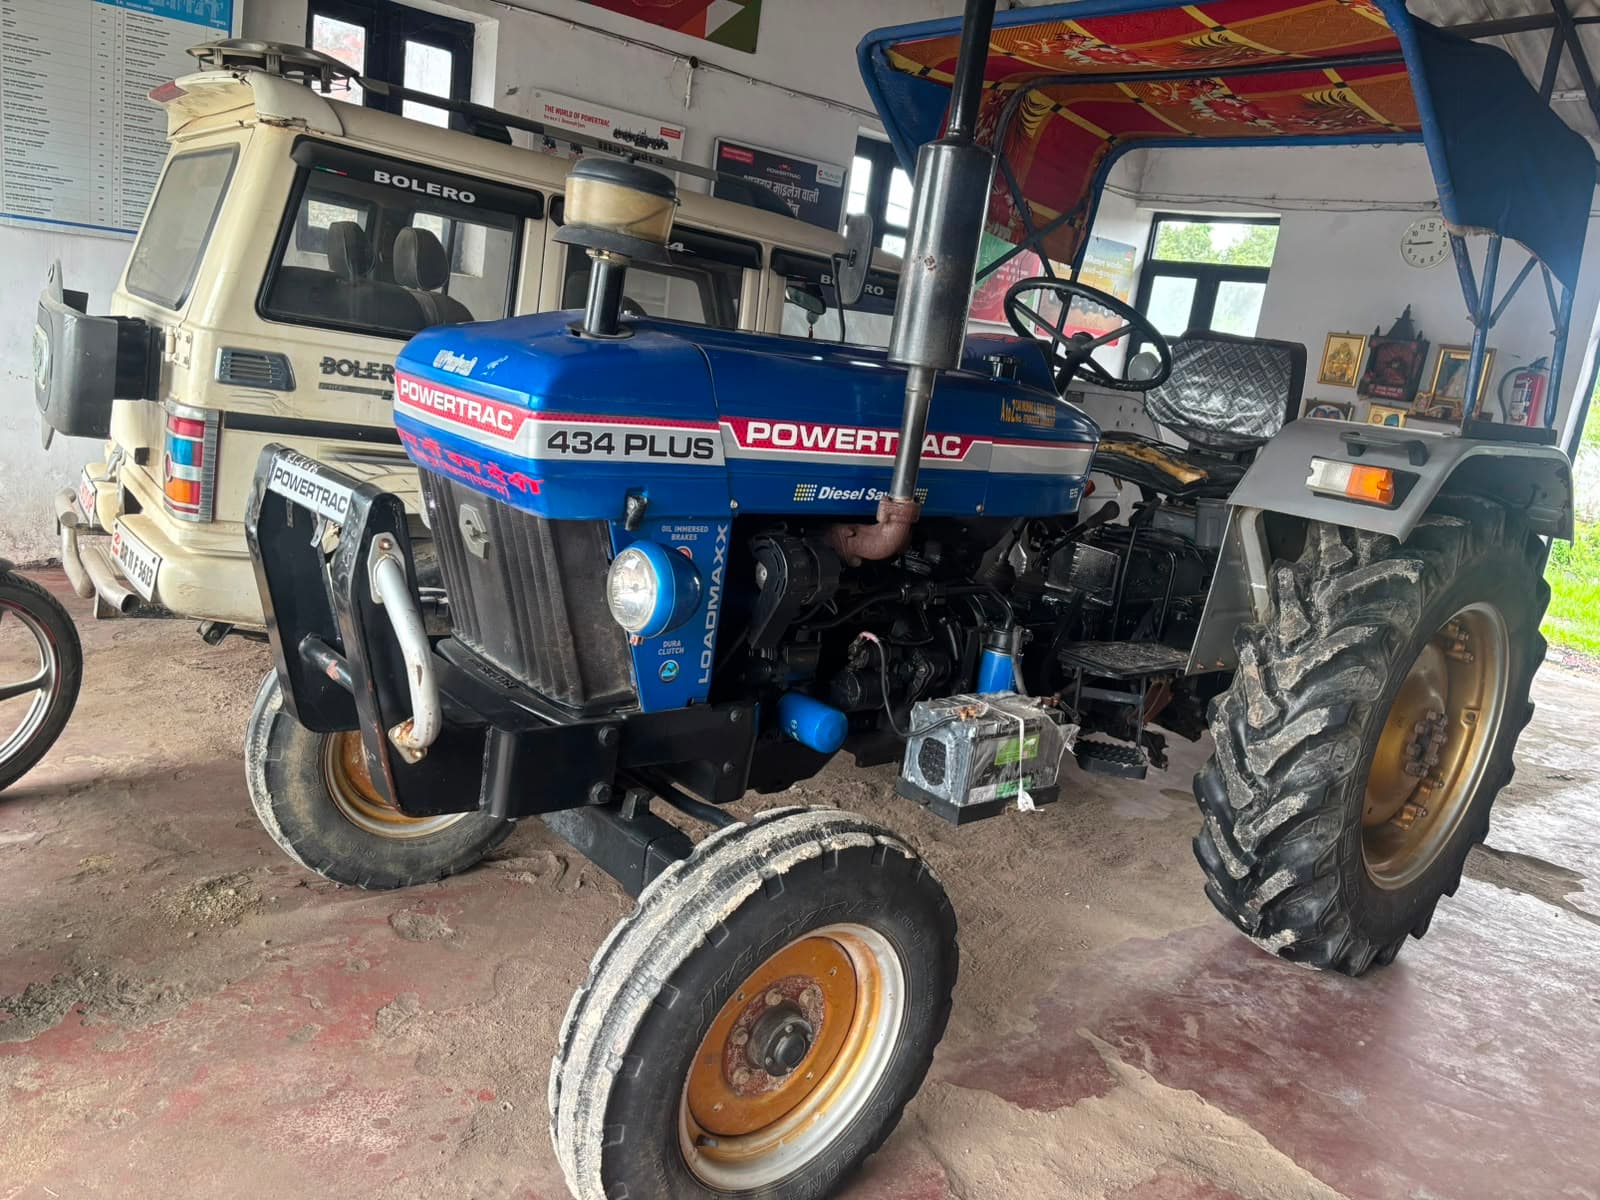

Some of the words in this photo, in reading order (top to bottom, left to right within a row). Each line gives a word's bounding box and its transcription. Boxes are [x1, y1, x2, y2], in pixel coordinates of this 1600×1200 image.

[544, 104, 554, 114] THE
[555, 107, 572, 118] WORLD
[573, 112, 580, 120] OF
[581, 113, 610, 127] POWERTRAC
[766, 167, 801, 180] POWERTRAC
[374, 170, 476, 204] BOLERO
[773, 181, 801, 199] माइलेज
[801, 188, 820, 204] वाली
[820, 274, 885, 296] BRO
[319, 356, 395, 384] BOLER
[400, 378, 514, 433] POWERTRAC
[547, 430, 616, 456] 434
[623, 433, 715, 461] PLUS
[746, 421, 961, 456] POWERTAC
[273, 466, 348, 514] POWERTRAC
[818, 486, 866, 501] Diesel
[865, 487, 891, 501] Sav
[661, 525, 673, 533] OIL
[674, 525, 709, 533] IMMERSED
[671, 533, 698, 541] BRAKES
[698, 524, 728, 684] LOADMAXX
[658, 647, 685, 656] CLUTCH
[662, 640, 682, 649] DURA
